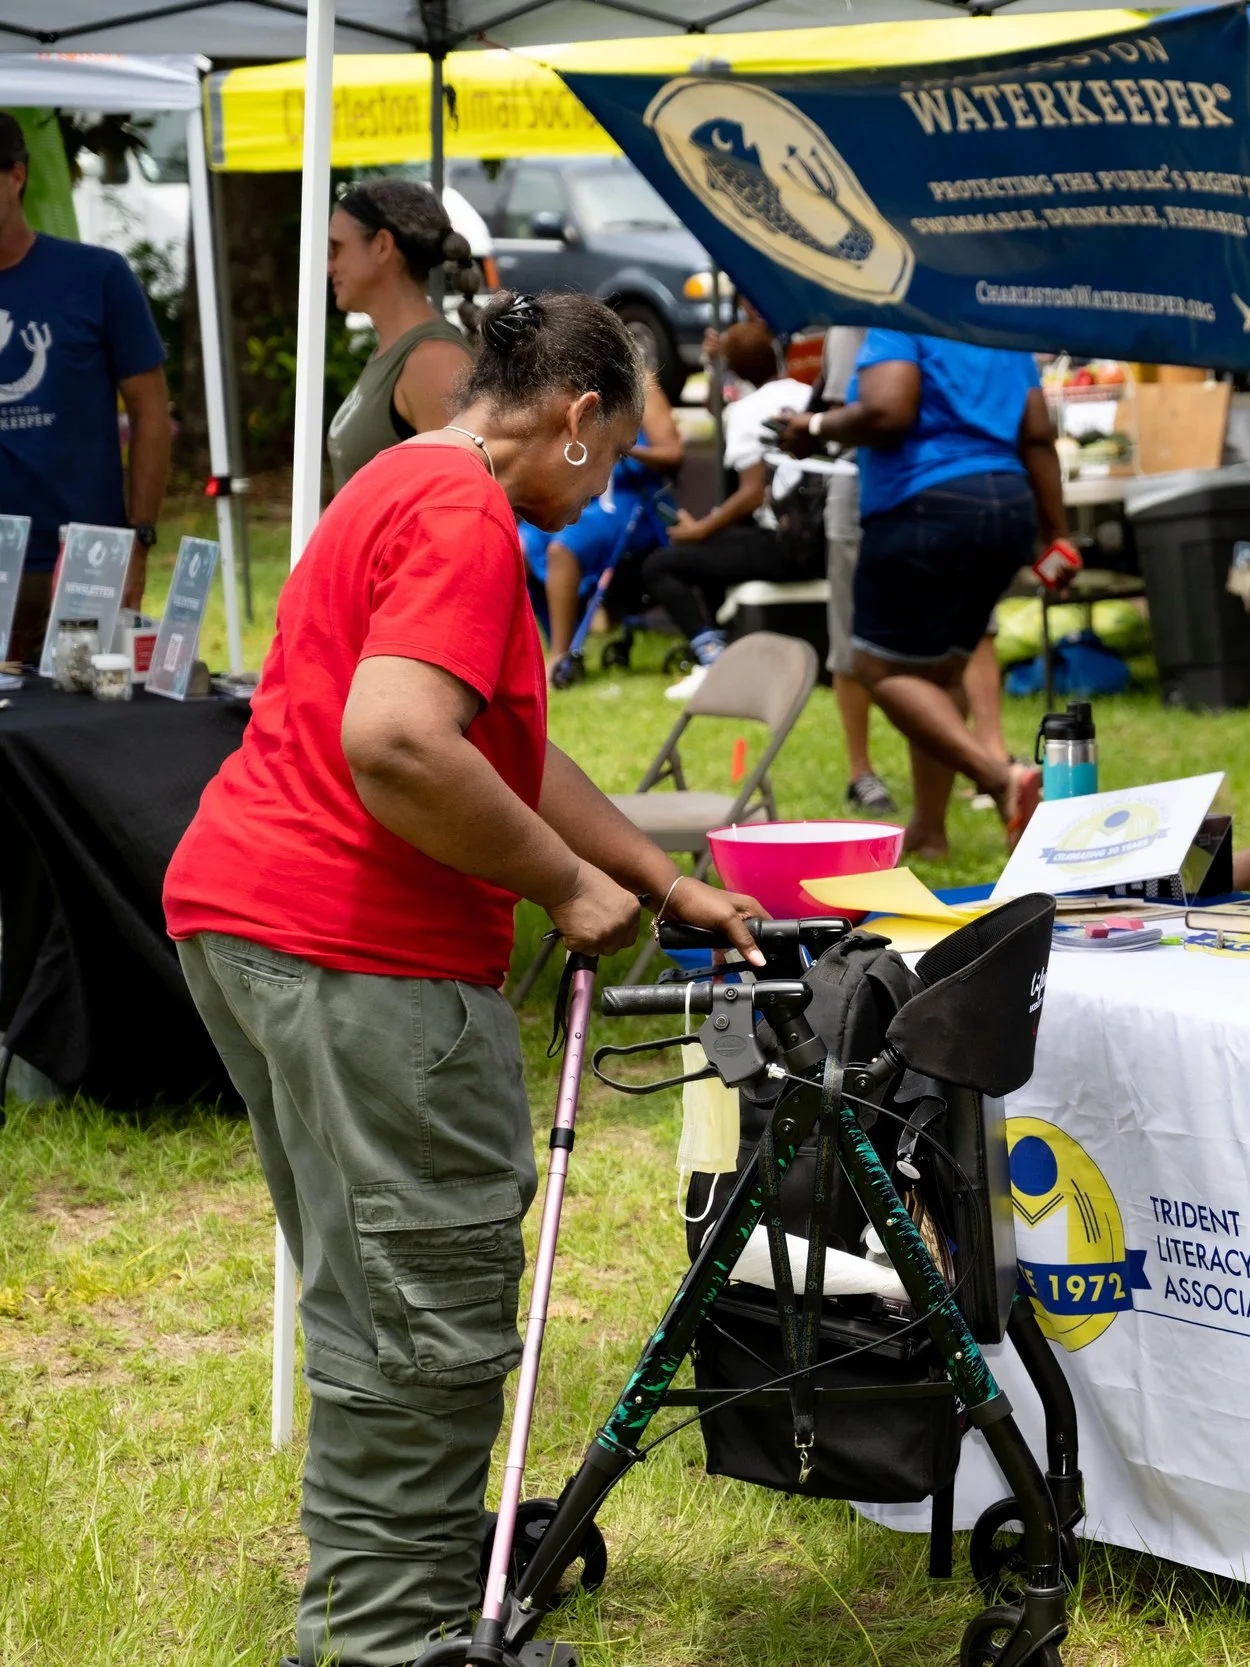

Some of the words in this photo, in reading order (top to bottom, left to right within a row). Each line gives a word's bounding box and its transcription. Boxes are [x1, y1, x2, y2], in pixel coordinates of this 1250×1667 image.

[282, 84, 421, 146] Crleston
[927, 174, 1054, 201] PROTECTING
[1052, 172, 1099, 193] THE
[1184, 171, 1244, 197] RIGHT
[1149, 1196, 1241, 1237] TRIDENT
[1048, 1272, 1126, 1302] 1972
